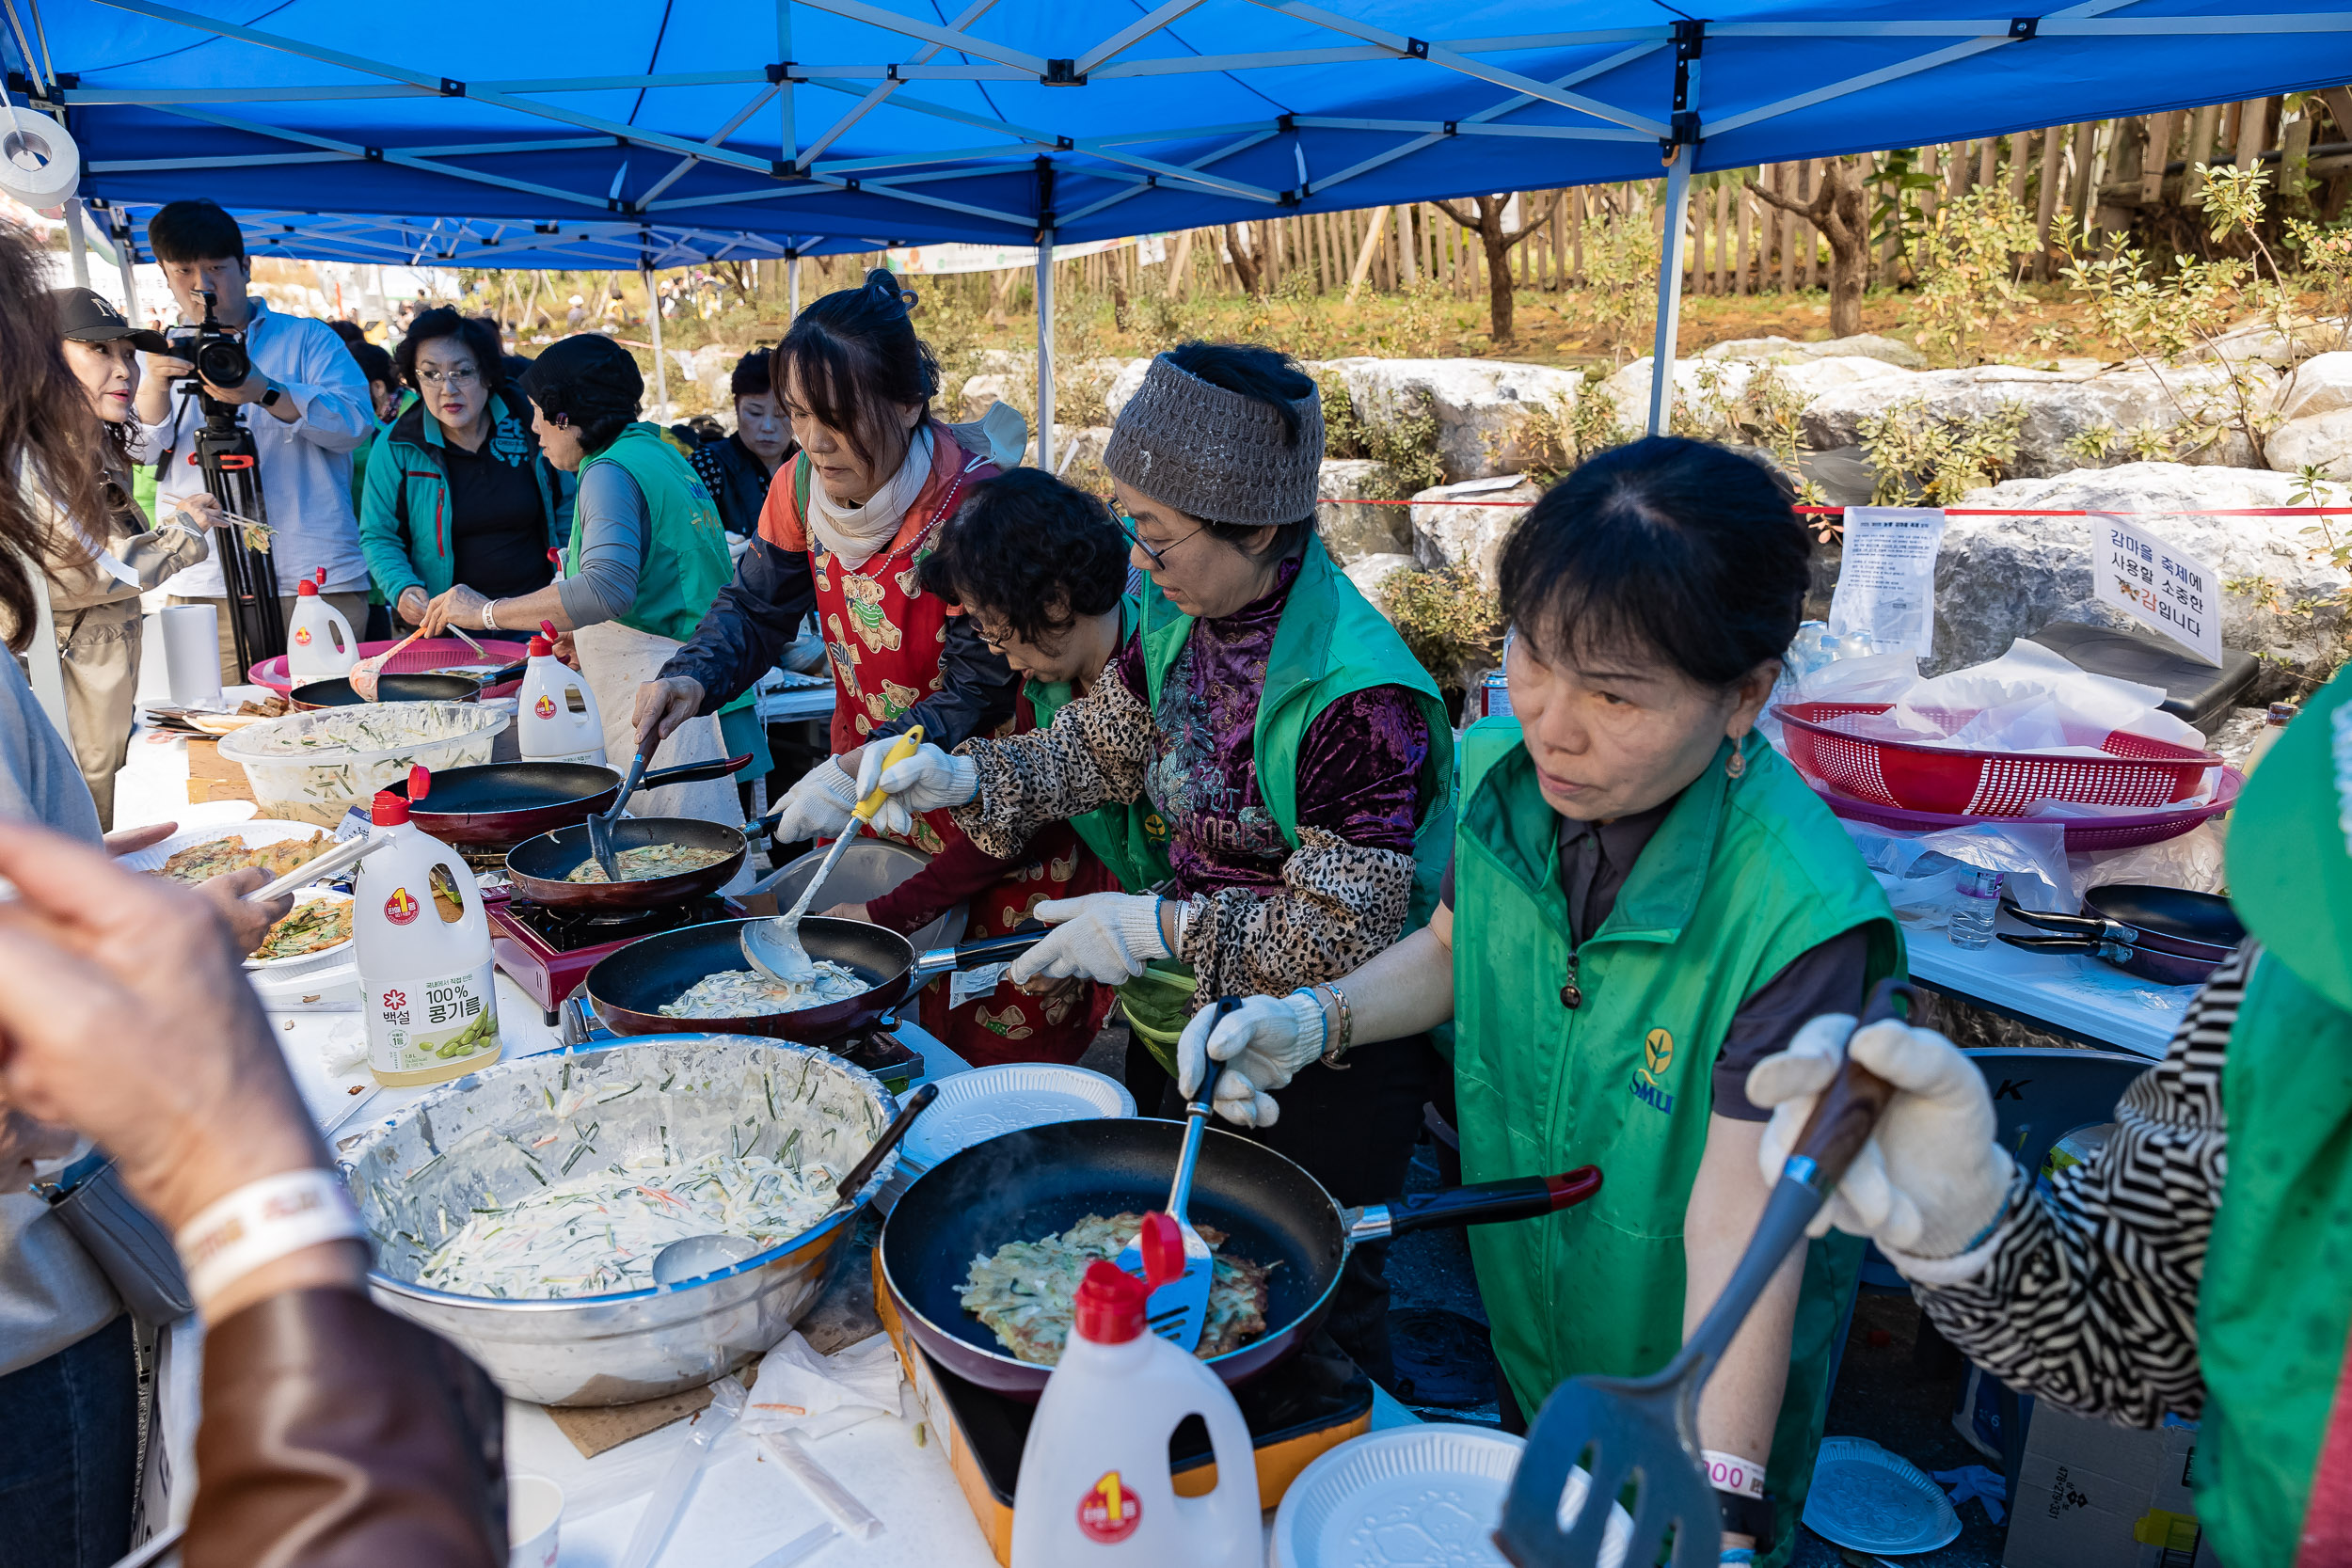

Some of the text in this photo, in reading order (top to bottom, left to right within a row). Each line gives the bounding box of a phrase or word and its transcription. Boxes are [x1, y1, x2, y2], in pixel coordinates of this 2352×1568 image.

[2110, 529, 2202, 593] 감마을 축제에
[2111, 552, 2203, 614] 사용할 소중한
[2141, 588, 2201, 638] 감입니다
[450, 976, 462, 985] 직접
[383, 1010, 410, 1025] 백설
[428, 996, 481, 1024] 콩기름
[1629, 1070, 1675, 1116] SMU
